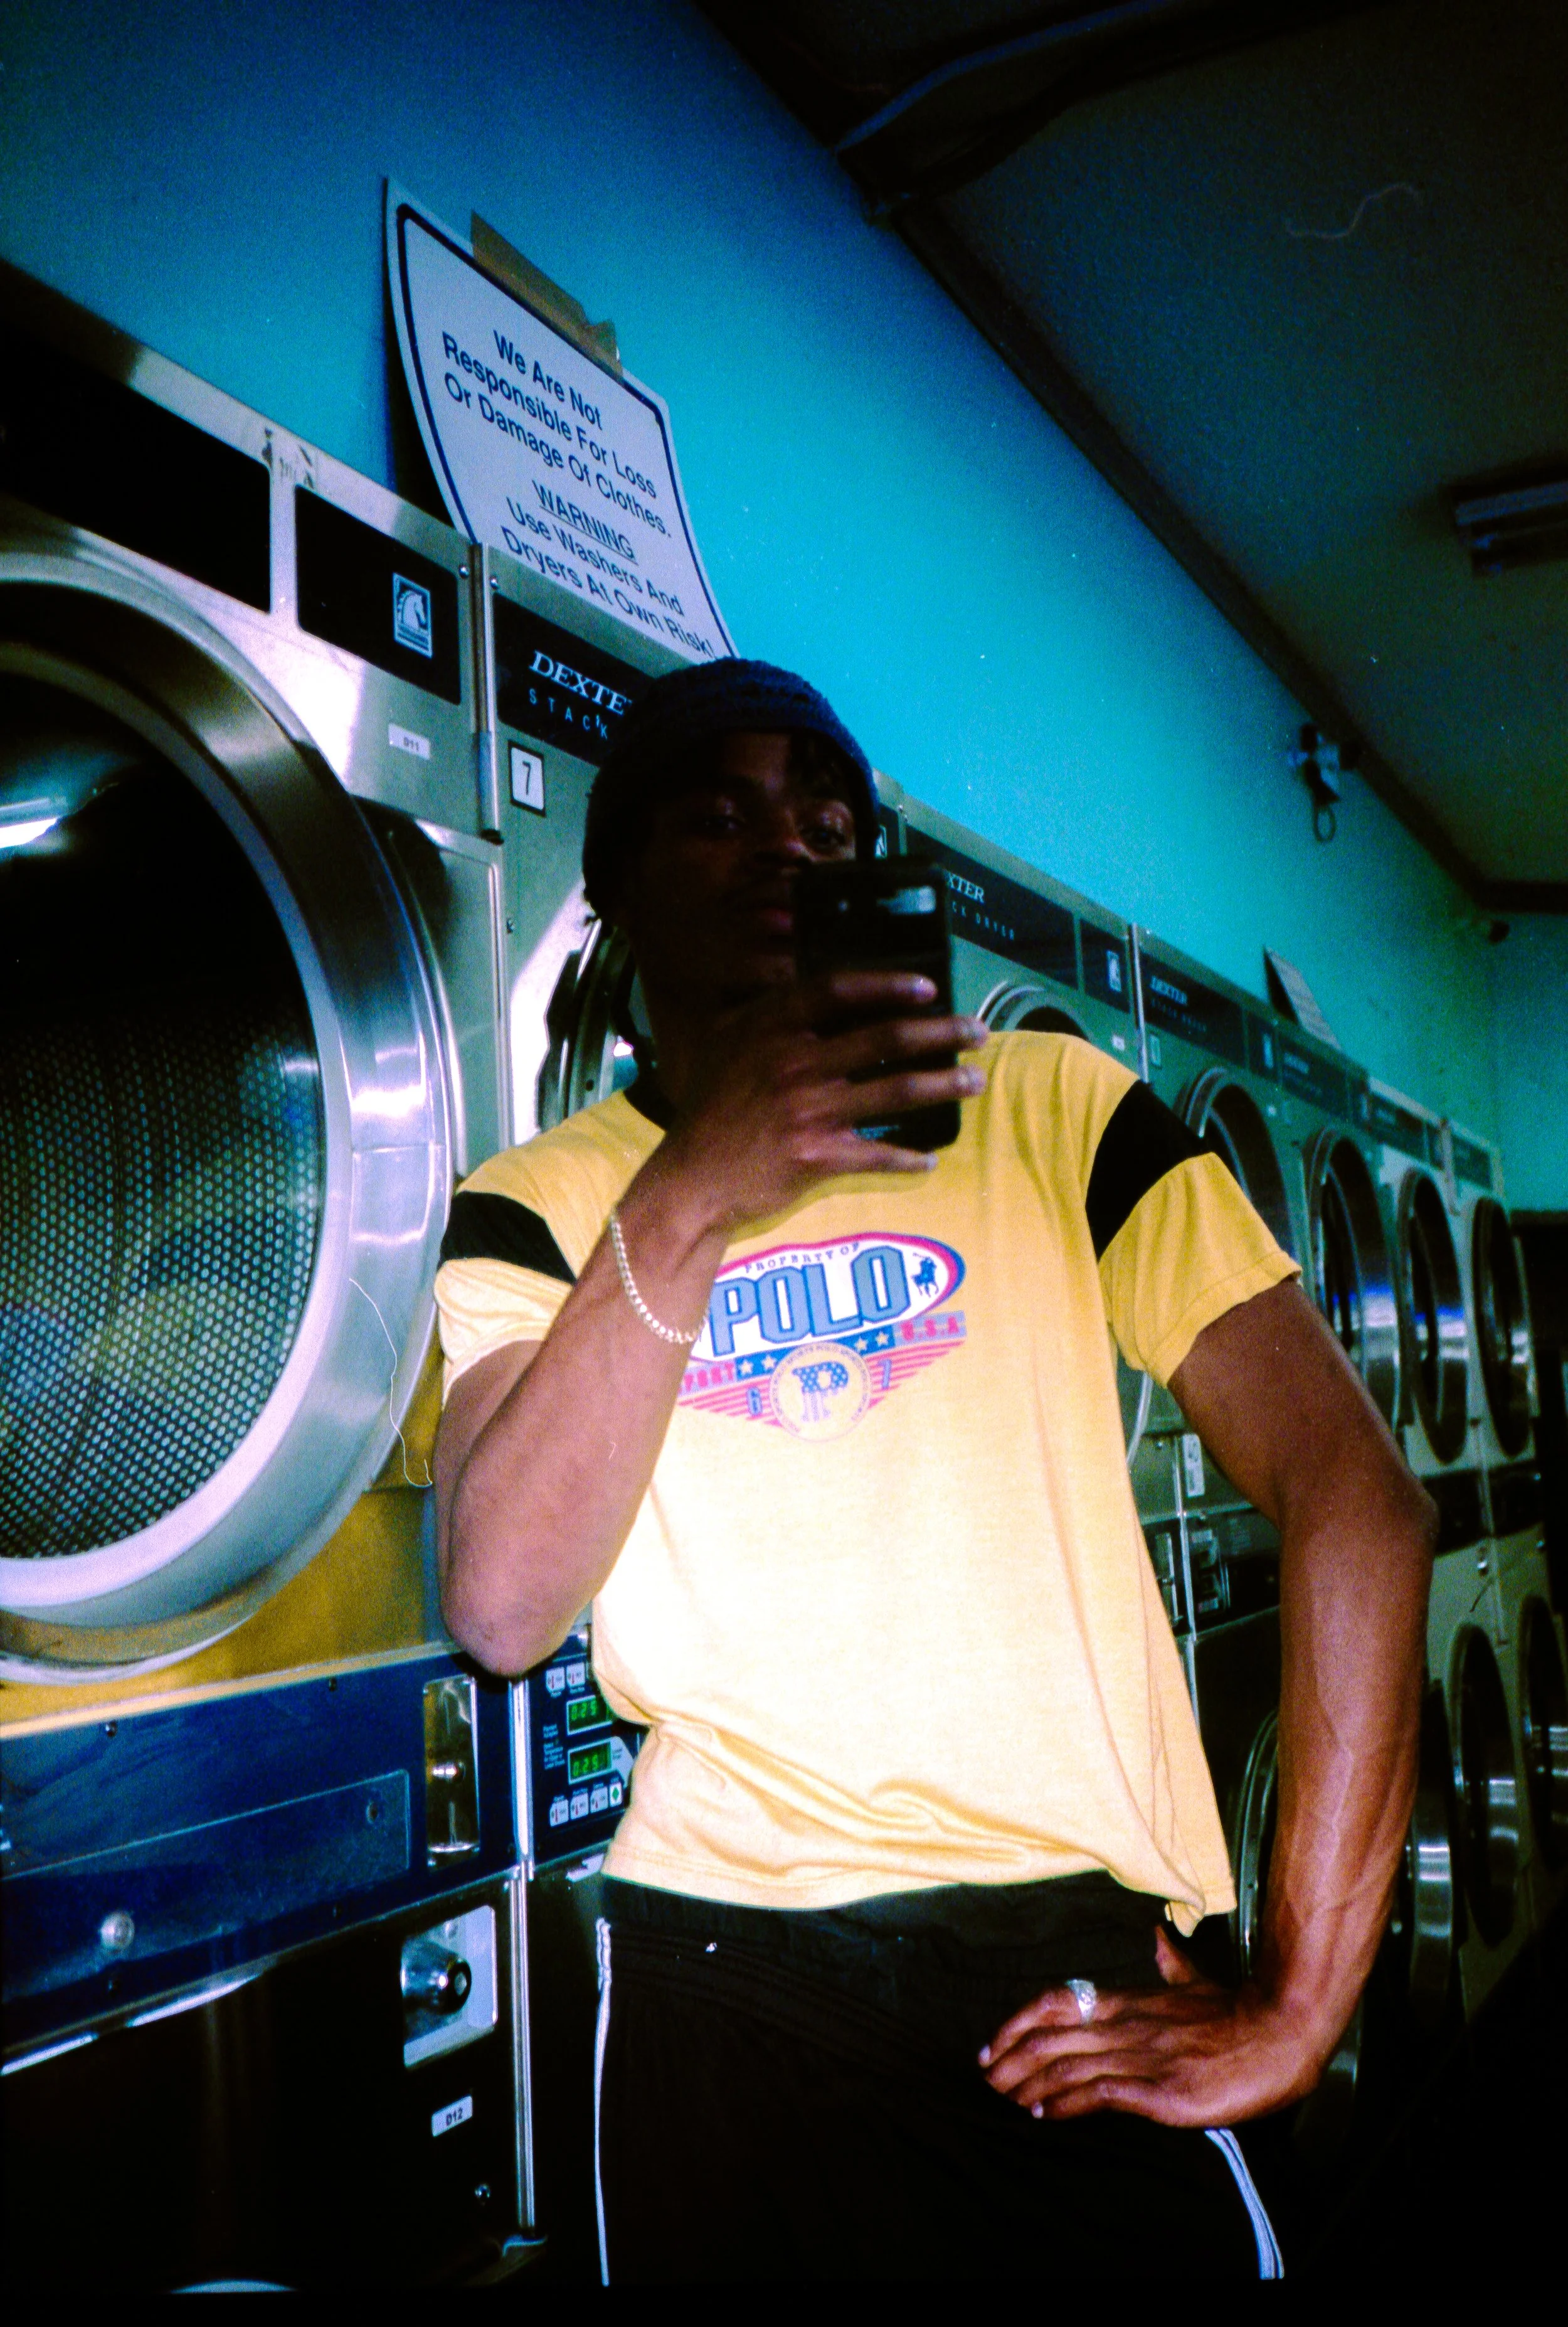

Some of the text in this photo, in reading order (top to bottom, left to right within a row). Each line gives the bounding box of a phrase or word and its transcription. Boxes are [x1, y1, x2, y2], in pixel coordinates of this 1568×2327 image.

[442, 331, 657, 499] Responsible For Loss
[494, 329, 603, 431] We Are Not
[444, 372, 672, 538] Or Damage Of Clothes.
[506, 496, 685, 617] Use Washers And
[531, 479, 636, 560] WARNING
[501, 526, 716, 659] Dryers At Own Risk!
[528, 649, 632, 716] DEXTE
[528, 688, 608, 740] STACK
[522, 759, 531, 796] 7
[709, 1245, 911, 1356] POLO
[745, 1241, 860, 1274] PROPERTY OF
[445, 2107, 464, 2127] D12
